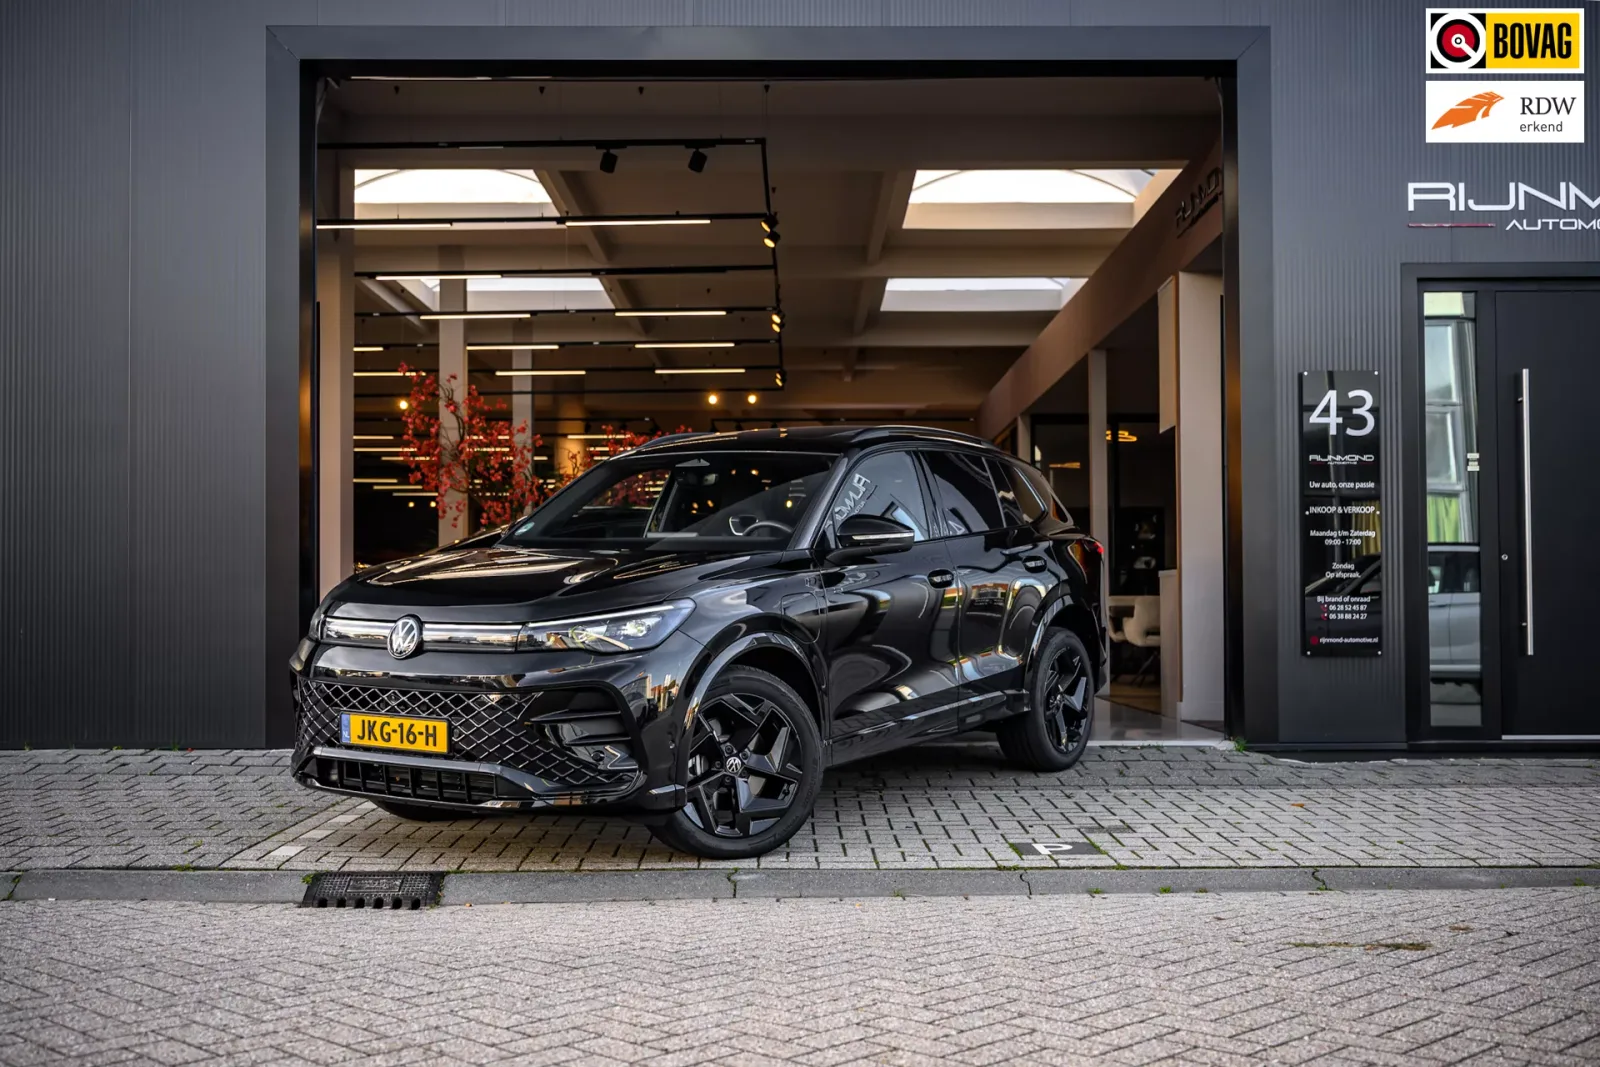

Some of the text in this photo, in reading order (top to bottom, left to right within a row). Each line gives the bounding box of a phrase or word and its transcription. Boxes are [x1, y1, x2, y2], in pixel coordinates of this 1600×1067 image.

[1505, 218, 1600, 231] AUTOM
[1309, 389, 1375, 436] 43
[1321, 481, 1337, 489] auto,
[1355, 481, 1375, 490] passie
[1309, 506, 1375, 514] INKOOP & VERKOOP
[1310, 529, 1376, 538] Maandag t/m Zaterdag
[1332, 562, 1355, 571] Zondag
[1325, 571, 1335, 579] Op
[342, 731, 350, 739] NL
[357, 719, 437, 747] JKG-16-H
[1031, 843, 1073, 855] P
